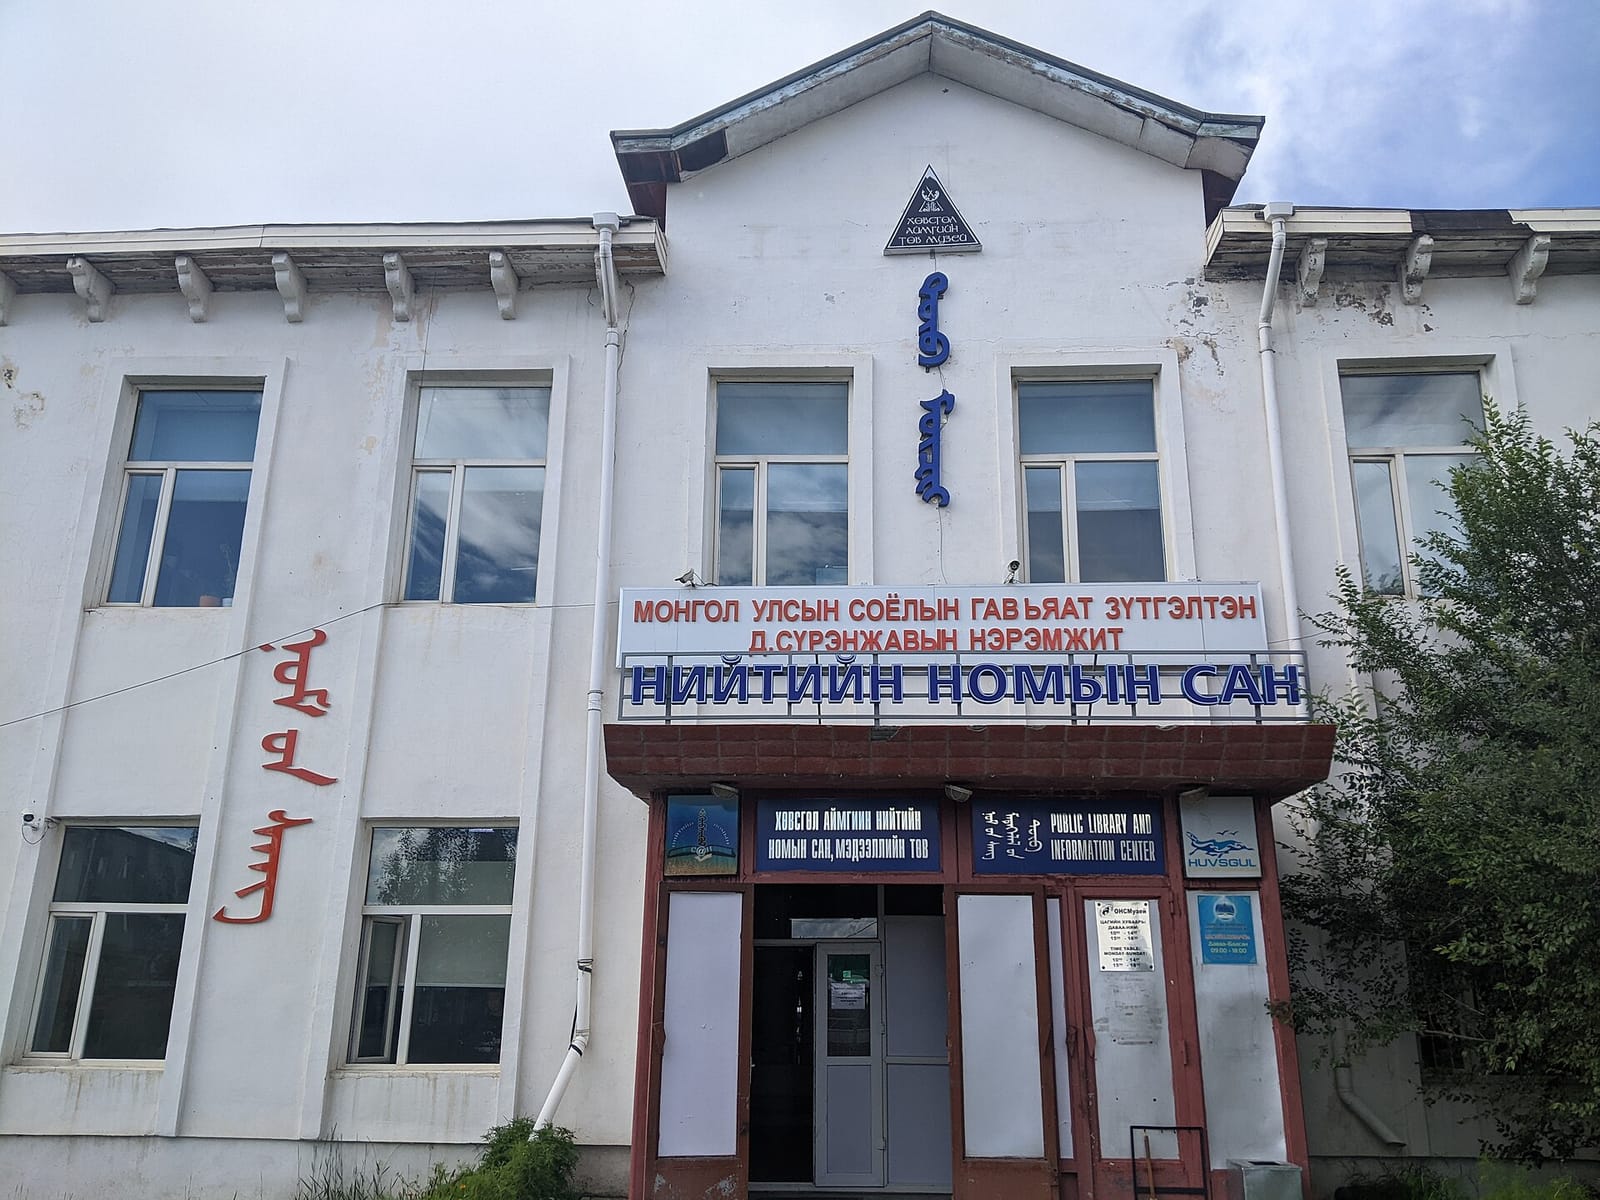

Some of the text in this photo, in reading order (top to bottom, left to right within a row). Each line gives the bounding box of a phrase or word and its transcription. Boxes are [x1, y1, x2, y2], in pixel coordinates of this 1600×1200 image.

[633, 593, 1257, 623] МОНГОЛ УЛСЫН СОЁЛЫН ГАВЬЯАТ ЗҮТГЭЛТЭН
[749, 627, 1124, 654] Д.СҮРЭНЖАВЫН НЭРЭМЖИТ
[630, 654, 1303, 706] НИЙТИЙН НОМЫН САН
[775, 811, 819, 831] ХӨВСГӨЛ
[876, 808, 922, 831] НИЙТИЙН
[1050, 813, 1153, 835] PUBLIC LIBRARY AND
[768, 838, 807, 860] НОМЫН
[835, 835, 906, 862] МЭДЭЭЛЛИЙН
[909, 838, 929, 859] ТӨВ
[1050, 839, 1156, 862] INFORMATION CENTER
[1188, 858, 1257, 868] HUVSGUL
